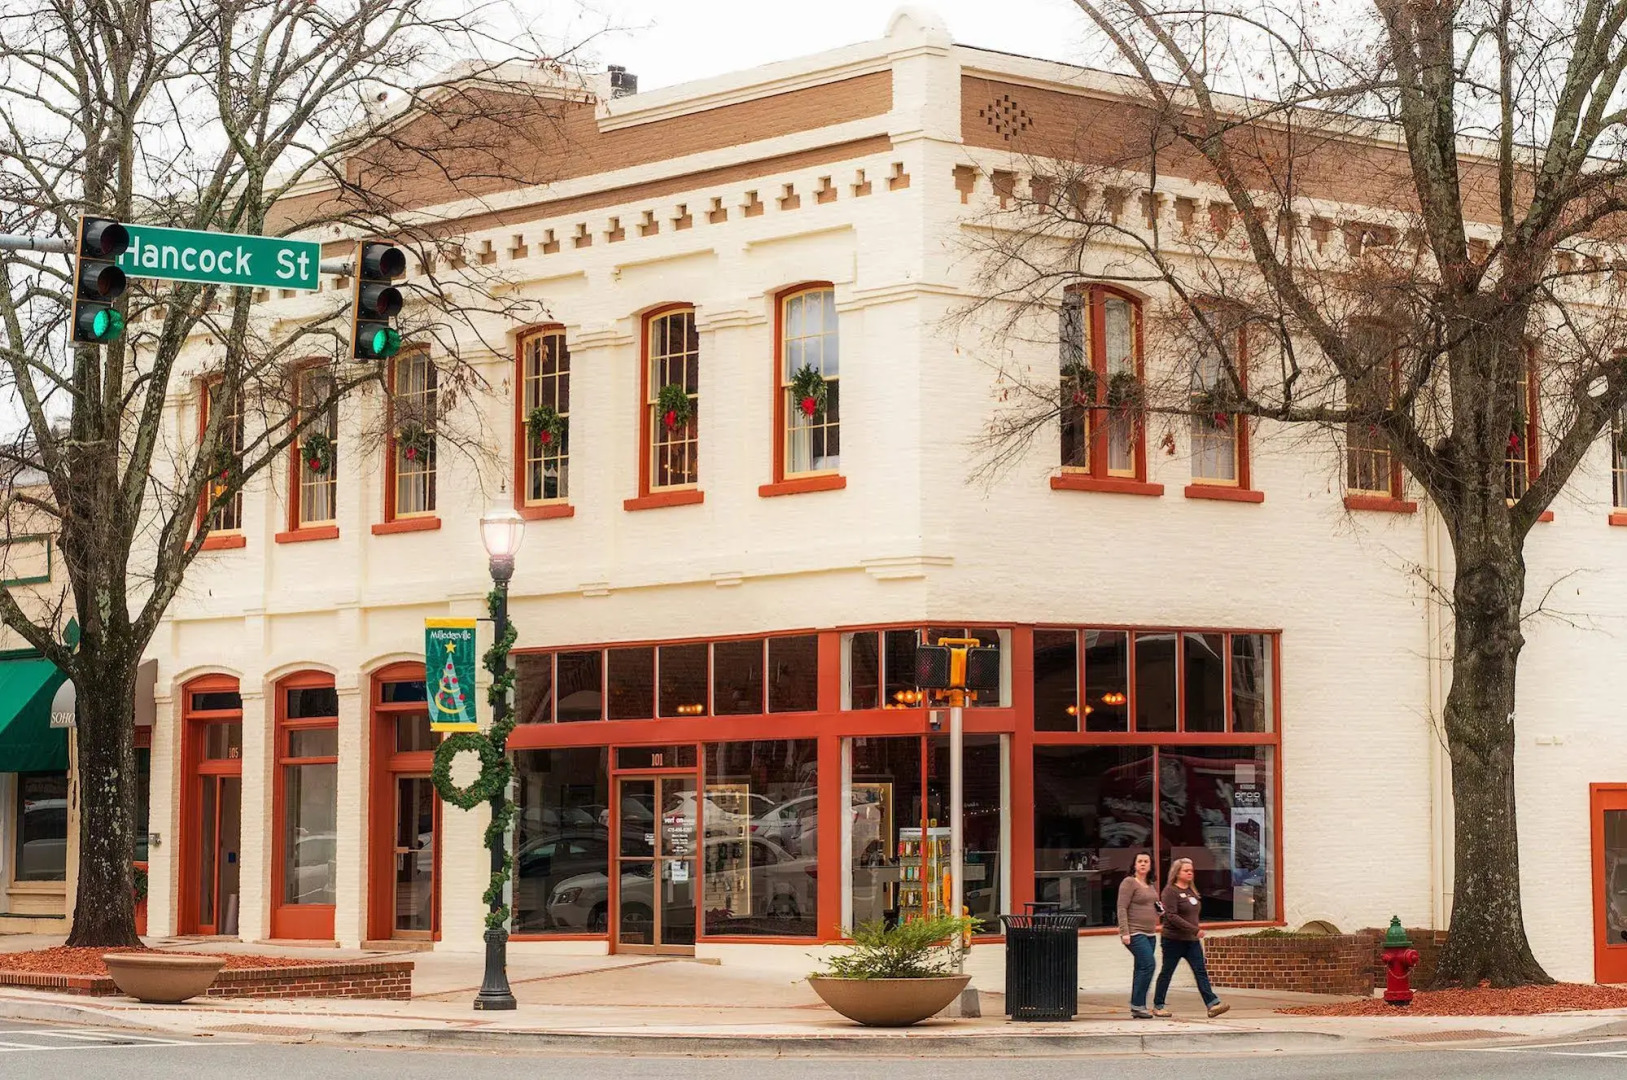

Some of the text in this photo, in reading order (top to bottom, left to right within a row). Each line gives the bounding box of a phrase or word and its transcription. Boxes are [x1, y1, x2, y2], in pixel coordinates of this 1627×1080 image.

[119, 236, 311, 281] Hancock St
[430, 630, 471, 640] Milledgeville
[51, 711, 75, 723] SOHO
[228, 747, 239, 759] 105
[651, 753, 663, 766] 101
